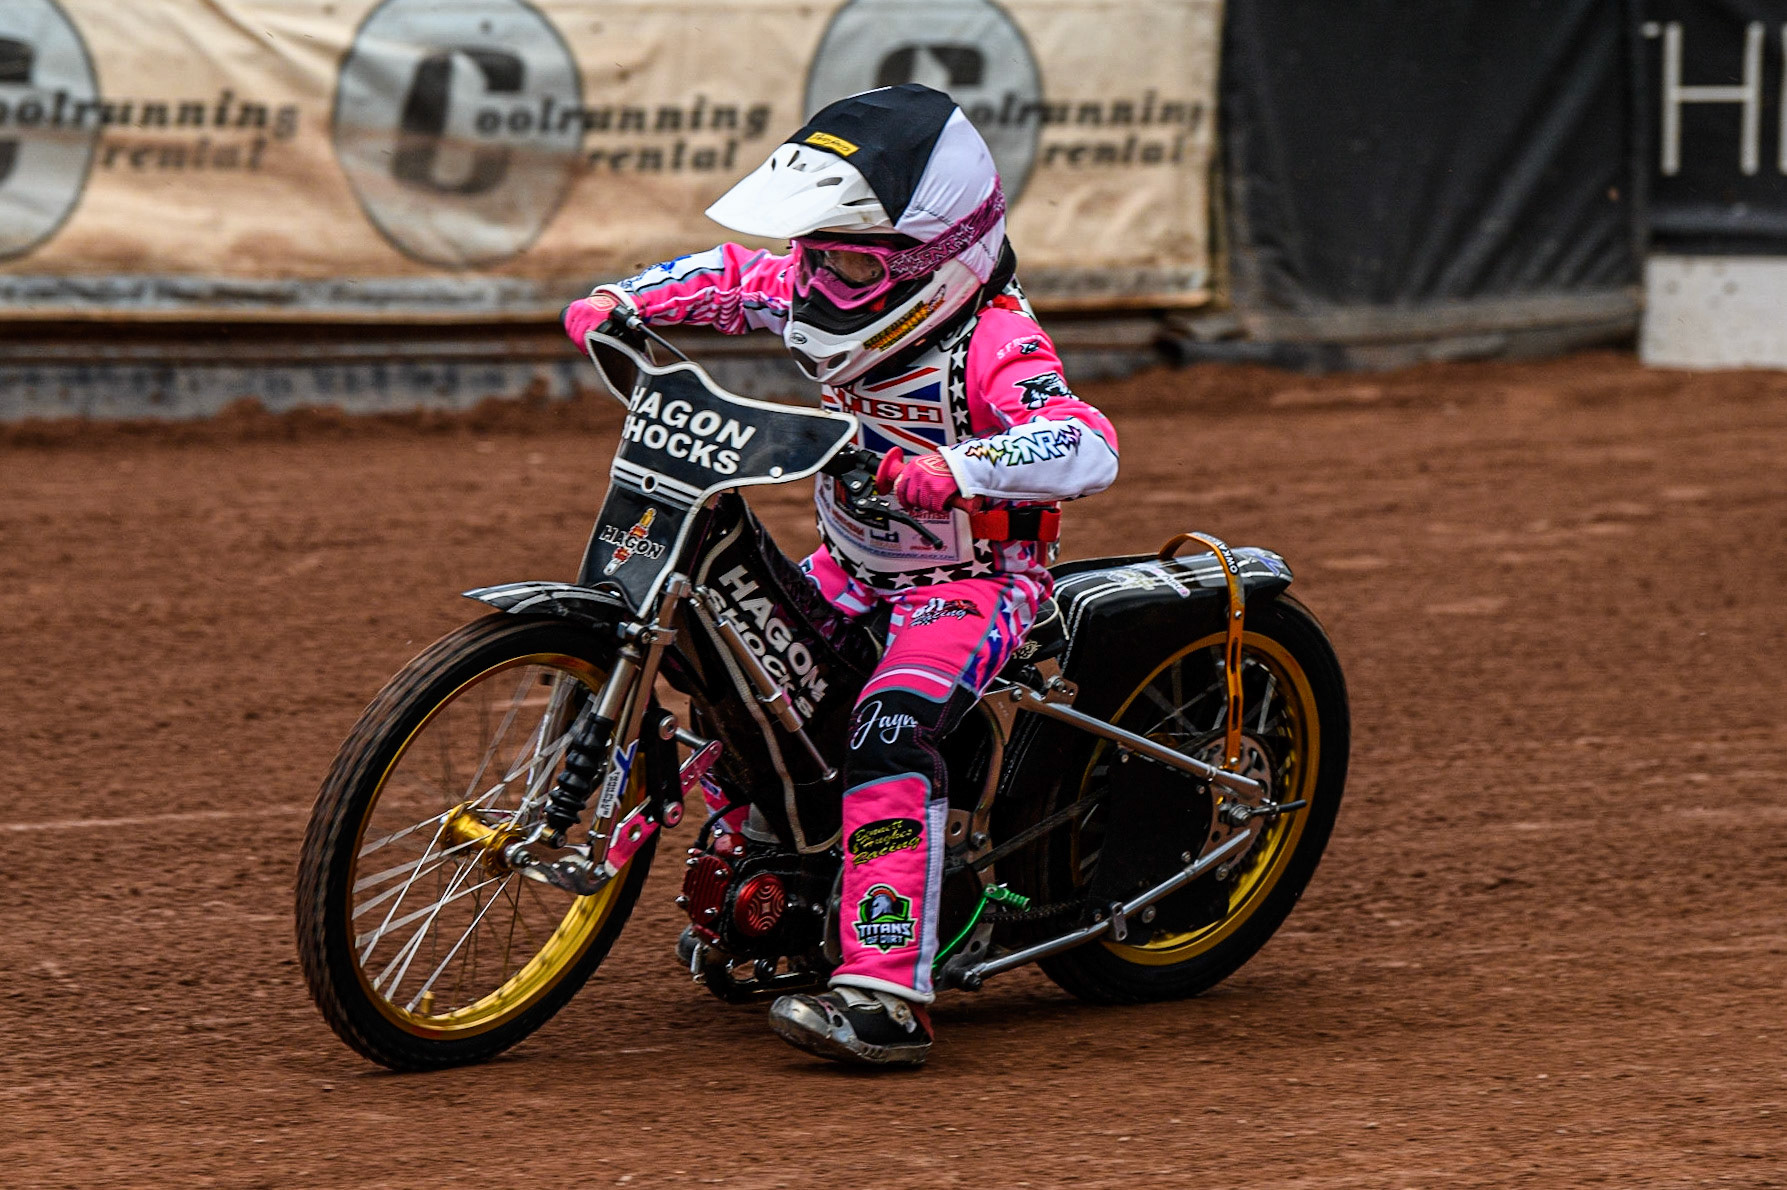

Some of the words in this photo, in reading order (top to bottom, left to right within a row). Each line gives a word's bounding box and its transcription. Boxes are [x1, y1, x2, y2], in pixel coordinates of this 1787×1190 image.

[588, 140, 738, 170] rental
[1044, 134, 1184, 164] rental
[628, 385, 757, 450] HAGON
[622, 414, 741, 475] HOCKS
[598, 525, 666, 560] HAGON
[718, 564, 829, 703] HAGON
[708, 588, 815, 719] SHOCKS
[853, 836, 920, 866] Racing
[857, 922, 912, 938] TITANS
